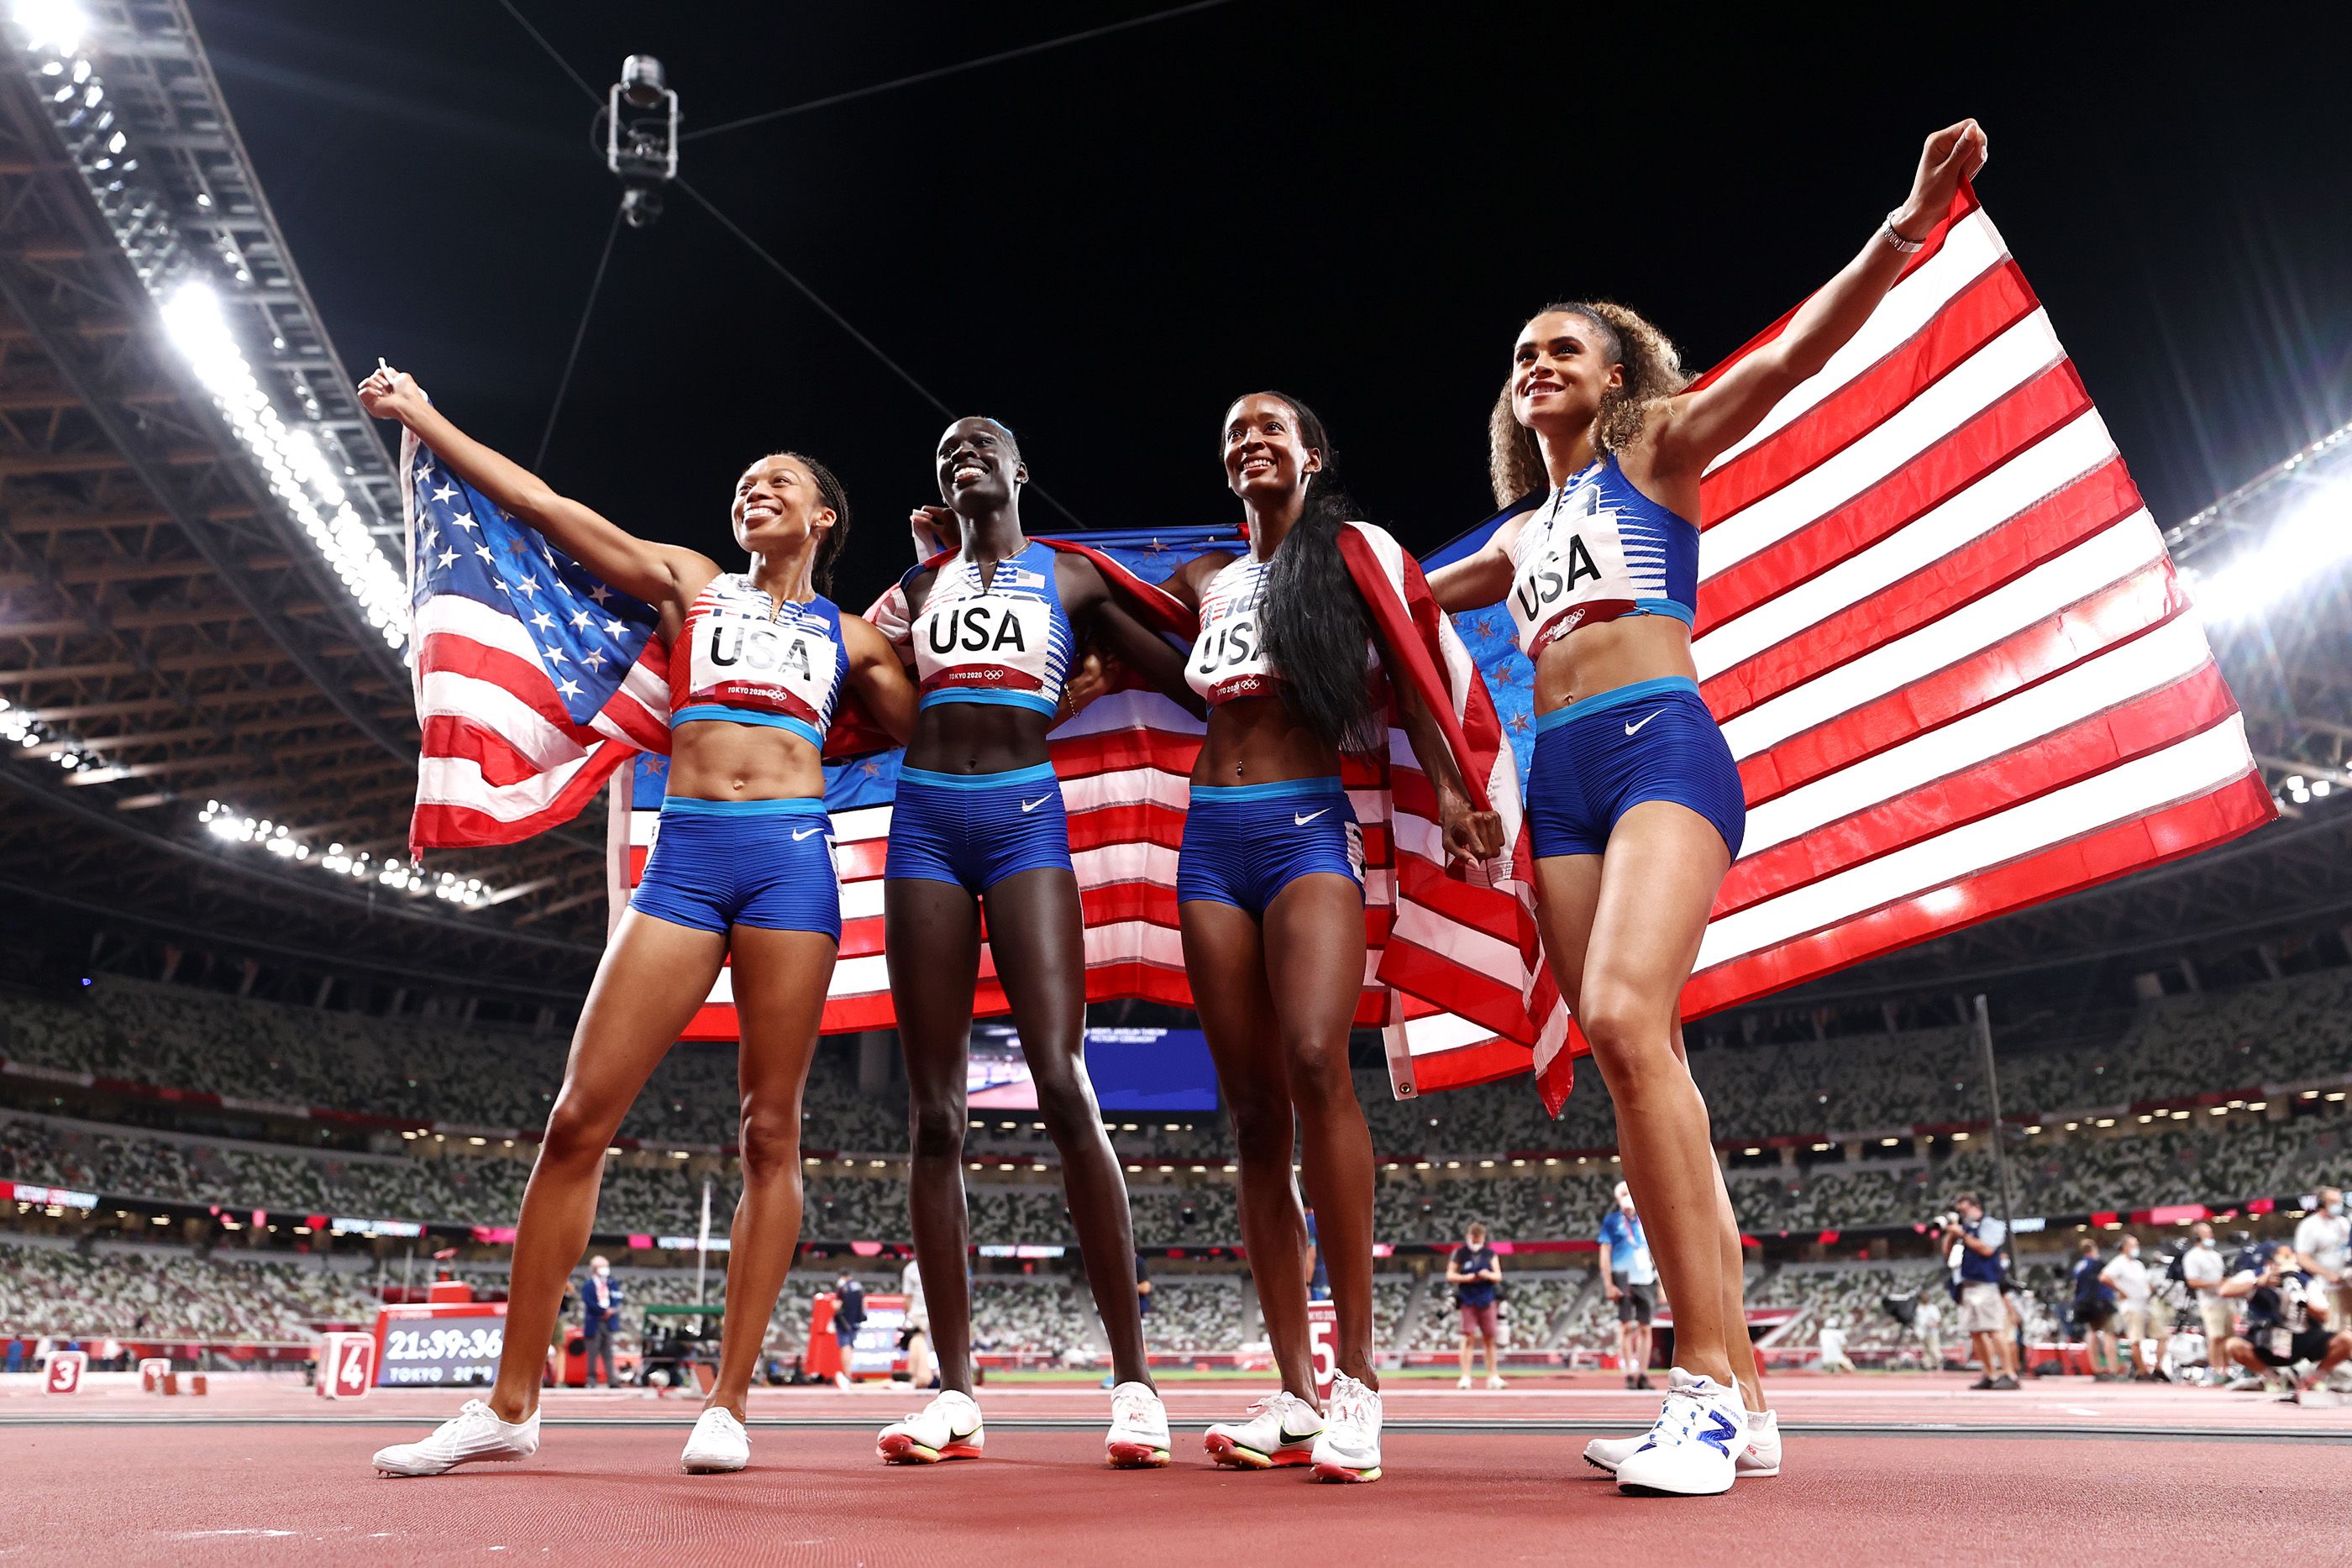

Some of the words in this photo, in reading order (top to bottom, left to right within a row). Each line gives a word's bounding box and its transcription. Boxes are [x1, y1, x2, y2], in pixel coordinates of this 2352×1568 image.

[1517, 534, 1602, 621] USA
[930, 607, 1026, 654] USA
[711, 627, 811, 682] USA
[727, 686, 748, 695] TOKYO
[749, 688, 766, 696] 2020
[386, 1329, 503, 1360] 21:39:36
[1310, 1322, 1336, 1386] 5
[52, 1360, 76, 1390] 3
[340, 1345, 364, 1389] 4
[390, 1366, 444, 1382] TOKYO
